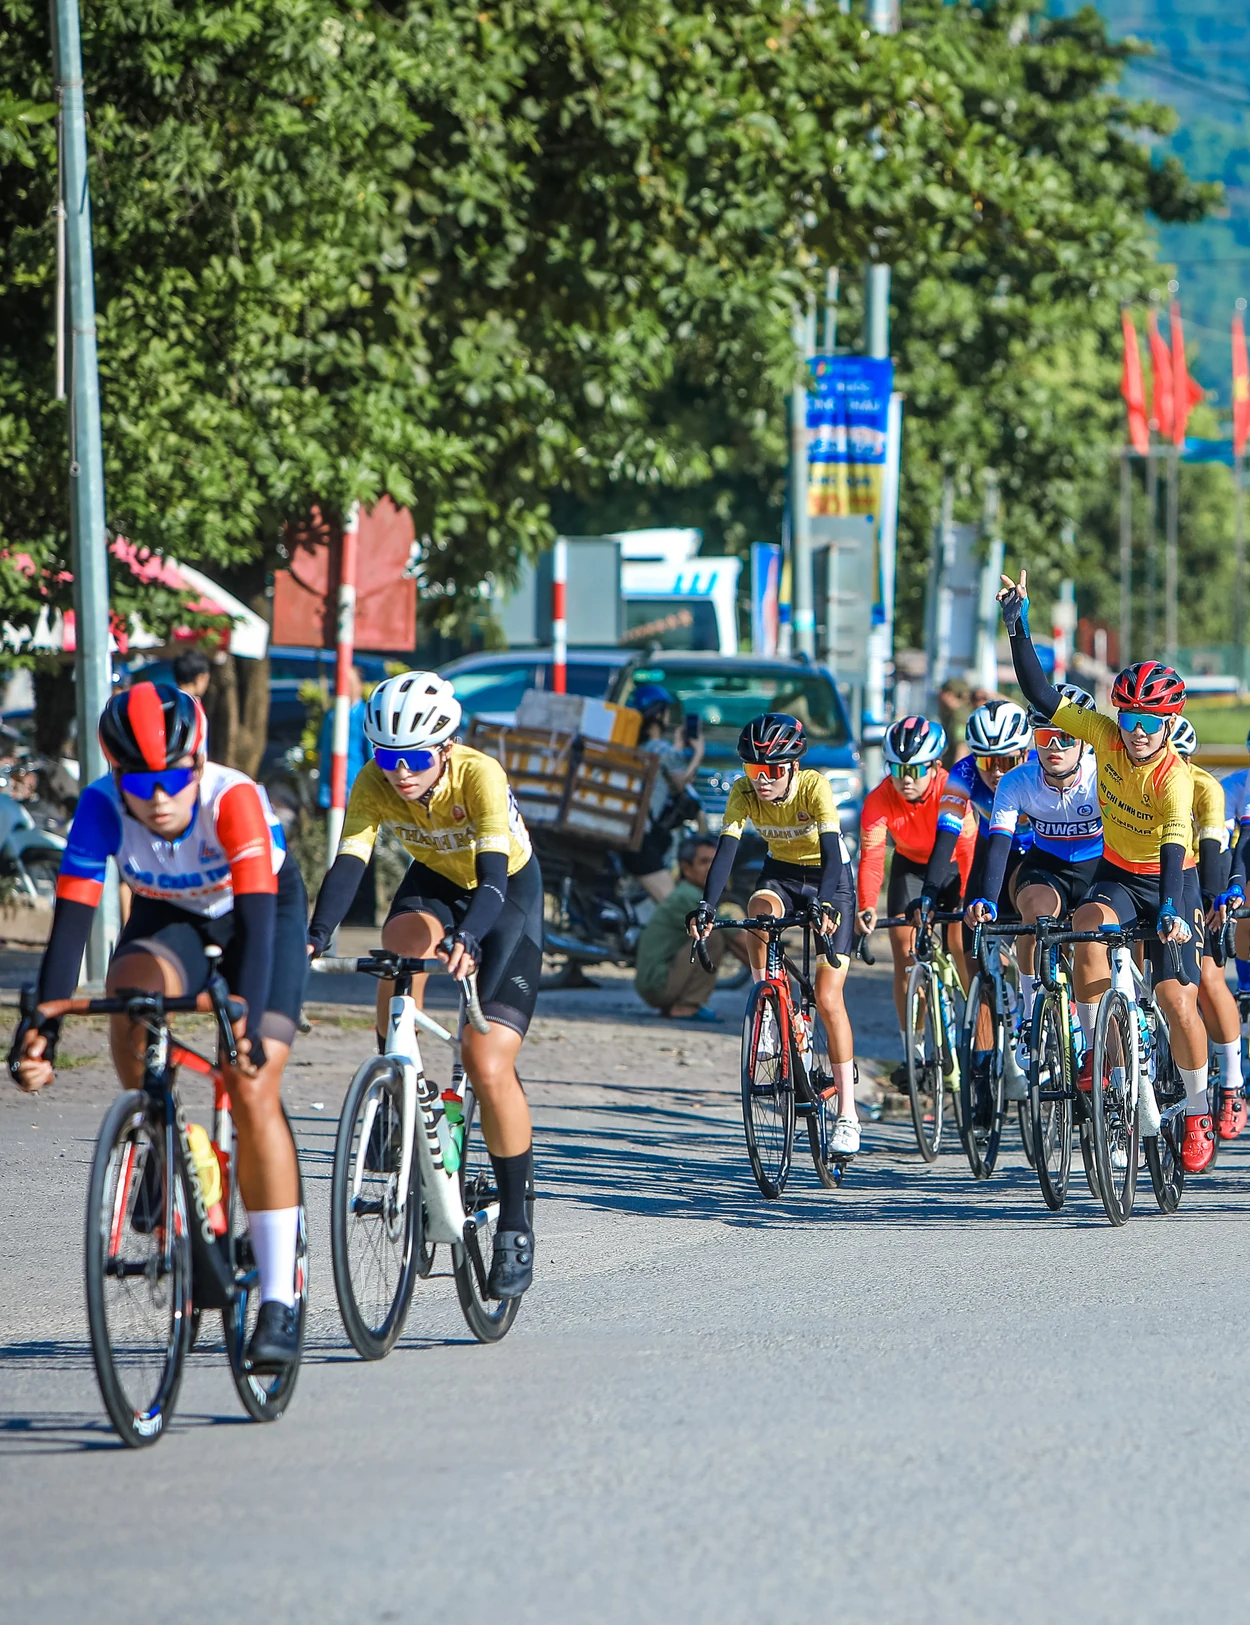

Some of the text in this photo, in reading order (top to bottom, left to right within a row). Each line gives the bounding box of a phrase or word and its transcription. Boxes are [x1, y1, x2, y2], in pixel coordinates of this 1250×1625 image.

[1106, 790, 1118, 805] CHI
[1118, 800, 1136, 816] MINH
[1136, 811, 1154, 821] CITY
[1035, 820, 1100, 836] BIWASE
[767, 942, 776, 980] GIANT
[1049, 942, 1057, 981] GIANT
